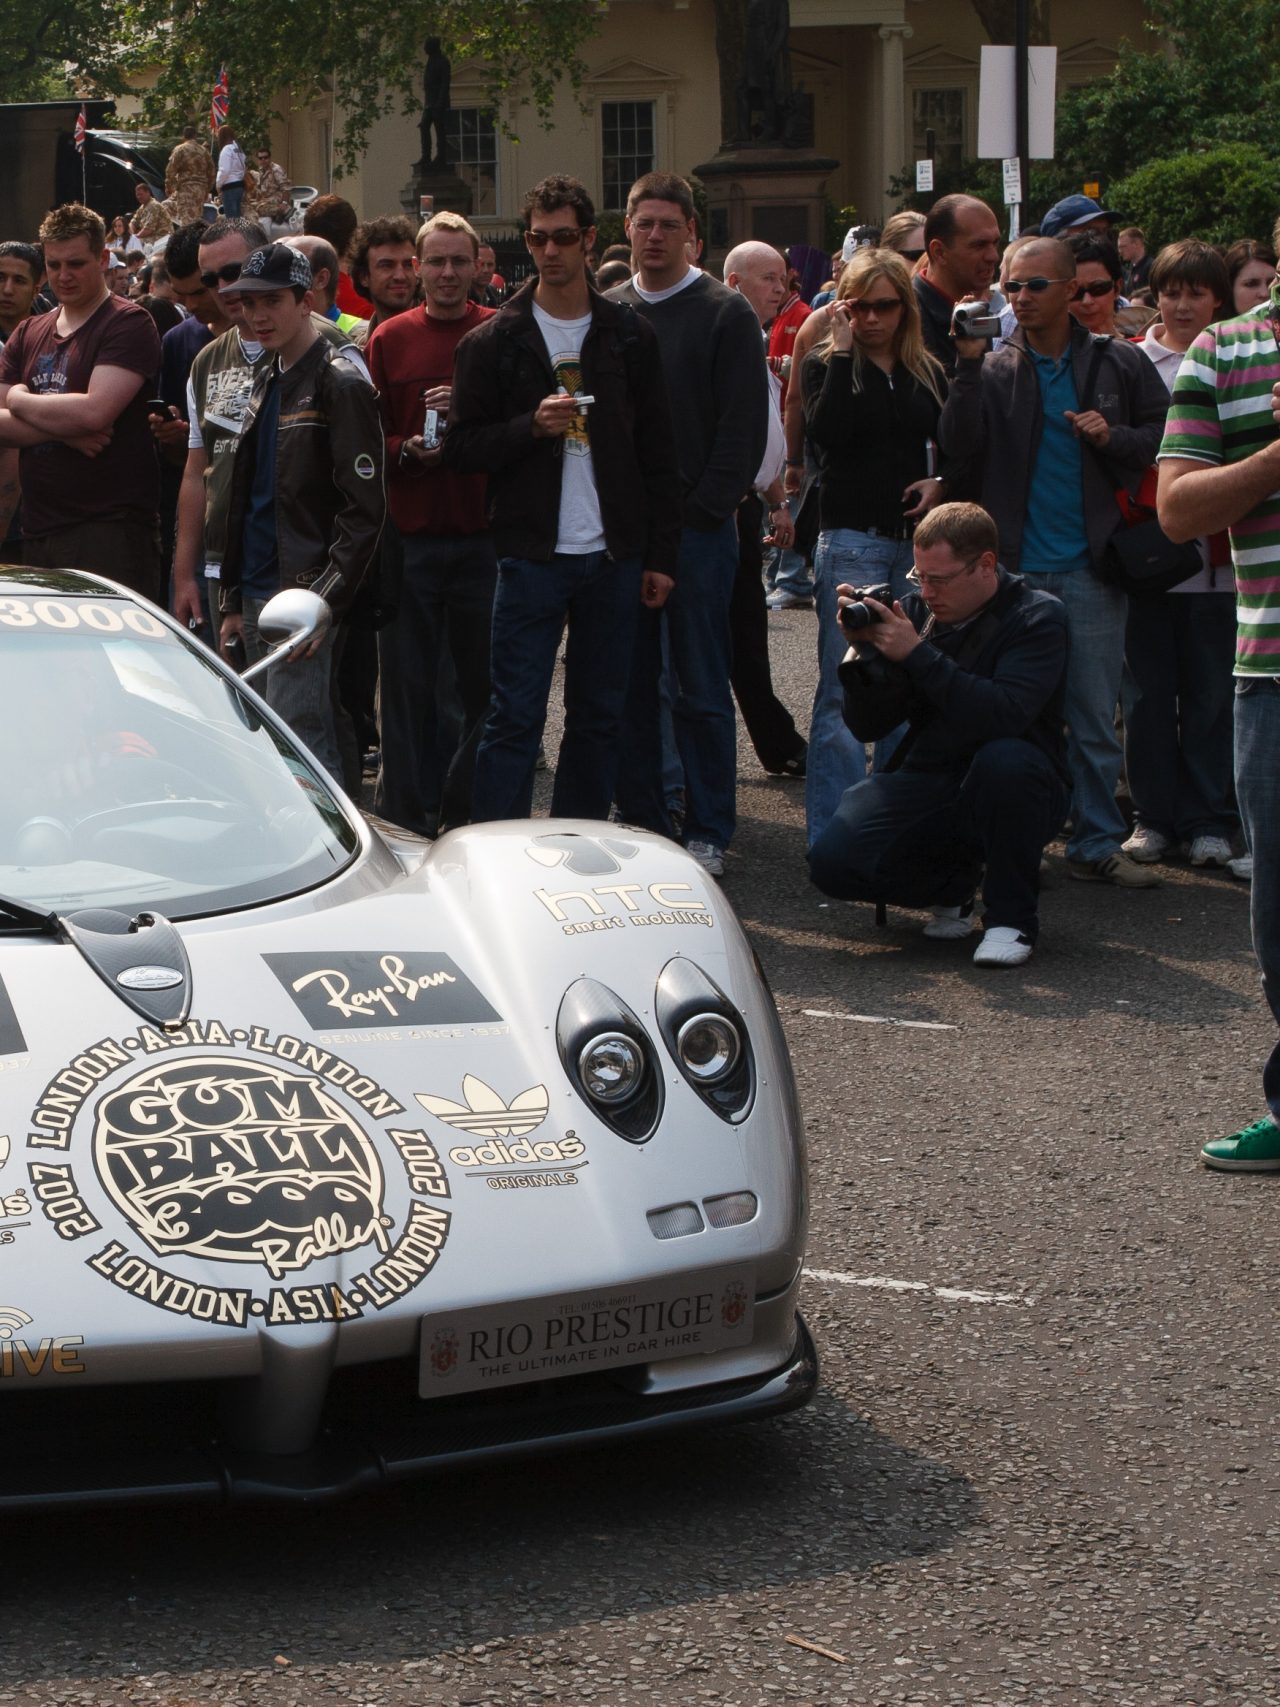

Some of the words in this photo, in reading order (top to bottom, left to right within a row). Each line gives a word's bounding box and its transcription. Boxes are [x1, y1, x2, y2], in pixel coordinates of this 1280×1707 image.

[213, 439, 230, 455] EST
[562, 914, 625, 936] smart
[629, 910, 714, 927] mobility
[292, 954, 457, 1018] Ray-Ban
[136, 1019, 235, 1055] ASIA
[319, 1030, 404, 1046] GENUINE
[408, 1028, 464, 1041] SINCE
[27, 1036, 135, 1151] LONDON
[248, 1025, 408, 1121] LONDON
[120, 1124, 370, 1192] BALL
[385, 1128, 452, 1199] 2007
[448, 1134, 587, 1167] adidas
[486, 1171, 579, 1190] ORIGINALS
[27, 1161, 102, 1241] 2007
[252, 1211, 393, 1280] Rally
[358, 1200, 452, 1306] LONDON
[84, 1240, 254, 1328] LONDON
[265, 1283, 365, 1327] ASIA
[467, 1323, 533, 1363] RIO
[545, 1293, 715, 1350] PRESTIGE
[479, 1363, 513, 1378] THE
[519, 1350, 598, 1372] ULTIMATE
[603, 1345, 621, 1358] IN
[627, 1338, 658, 1354] CAR
[665, 1331, 702, 1346] HIRE
